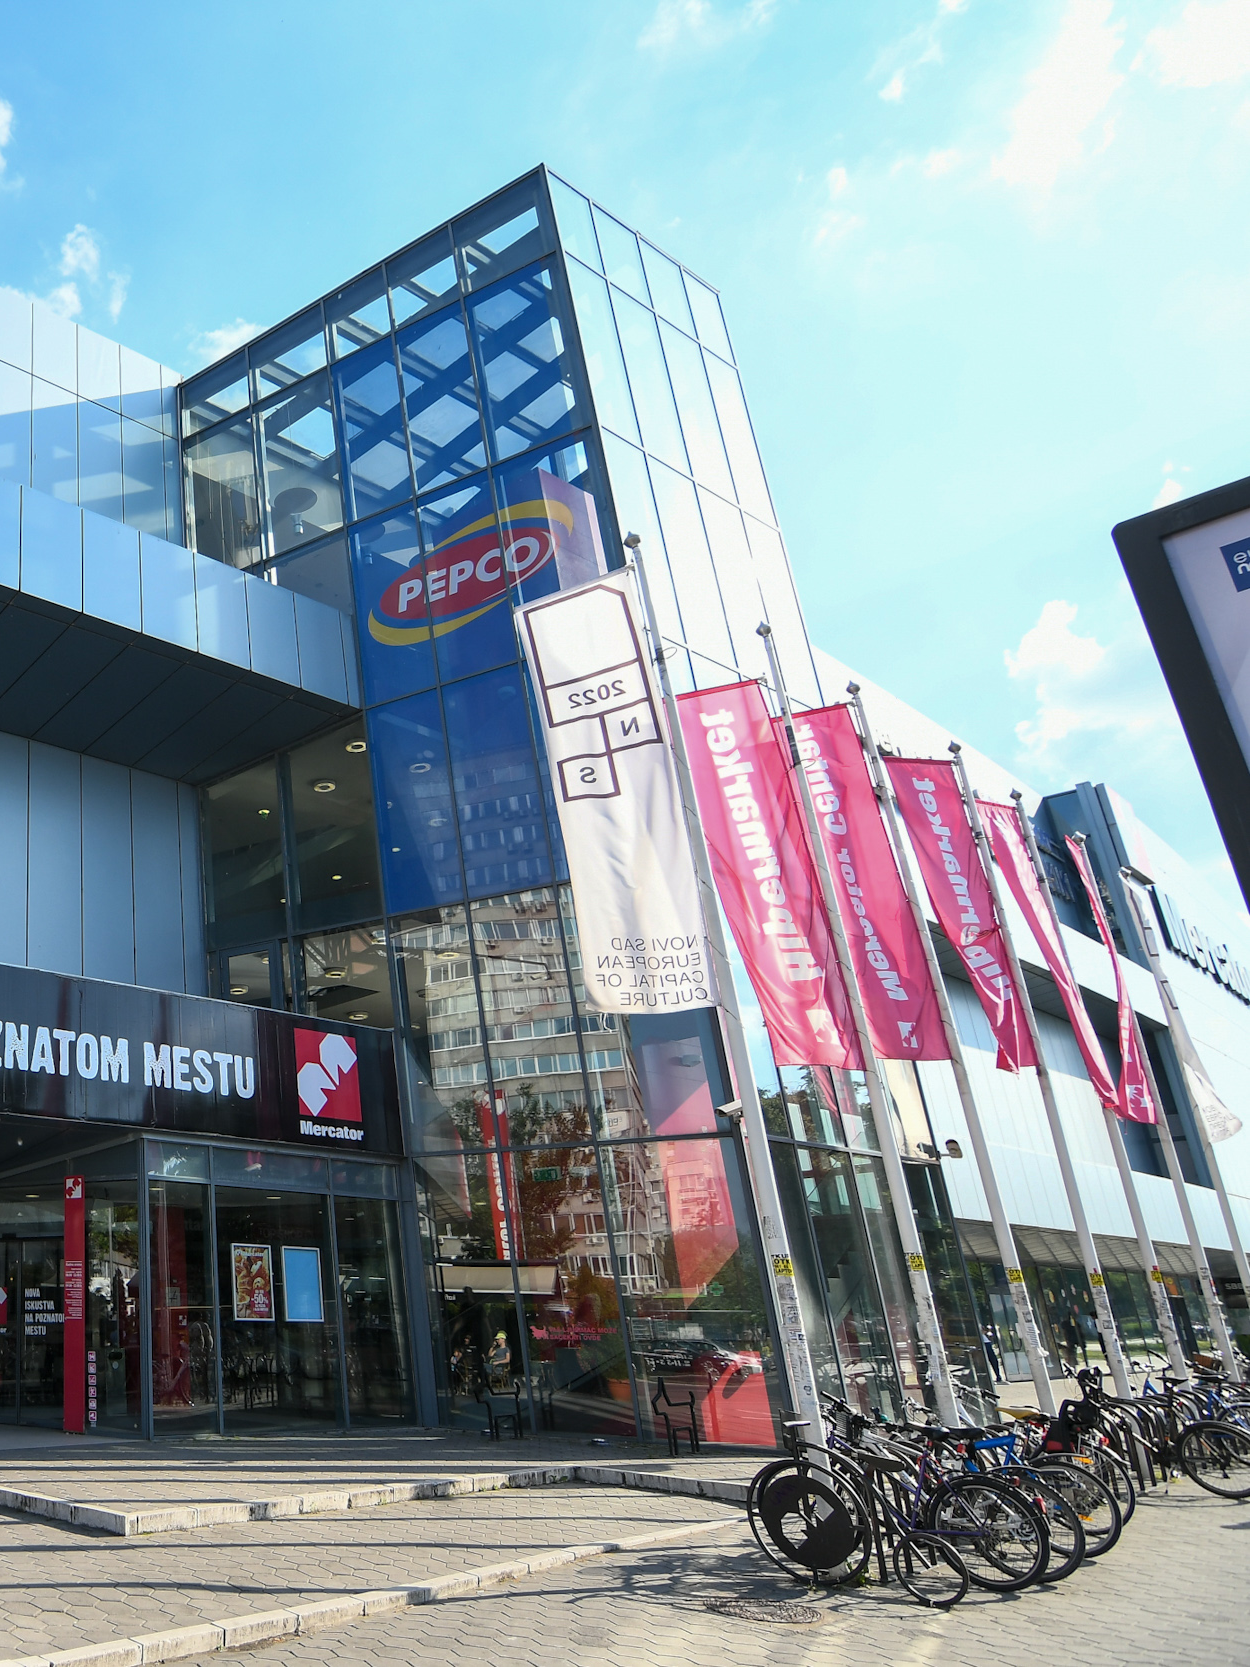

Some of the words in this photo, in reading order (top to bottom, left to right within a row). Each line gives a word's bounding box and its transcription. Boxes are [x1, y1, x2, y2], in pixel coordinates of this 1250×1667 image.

[398, 536, 540, 613] PEPCO
[143, 1042, 255, 1098] MESTU
[299, 1120, 365, 1141] Mercator
[25, 1288, 40, 1298] NOVA
[25, 1301, 55, 1310] ISKUSTVA
[25, 1313, 34, 1323] NA
[35, 1313, 64, 1323] POZNATO
[25, 1326, 47, 1335] MESTU
